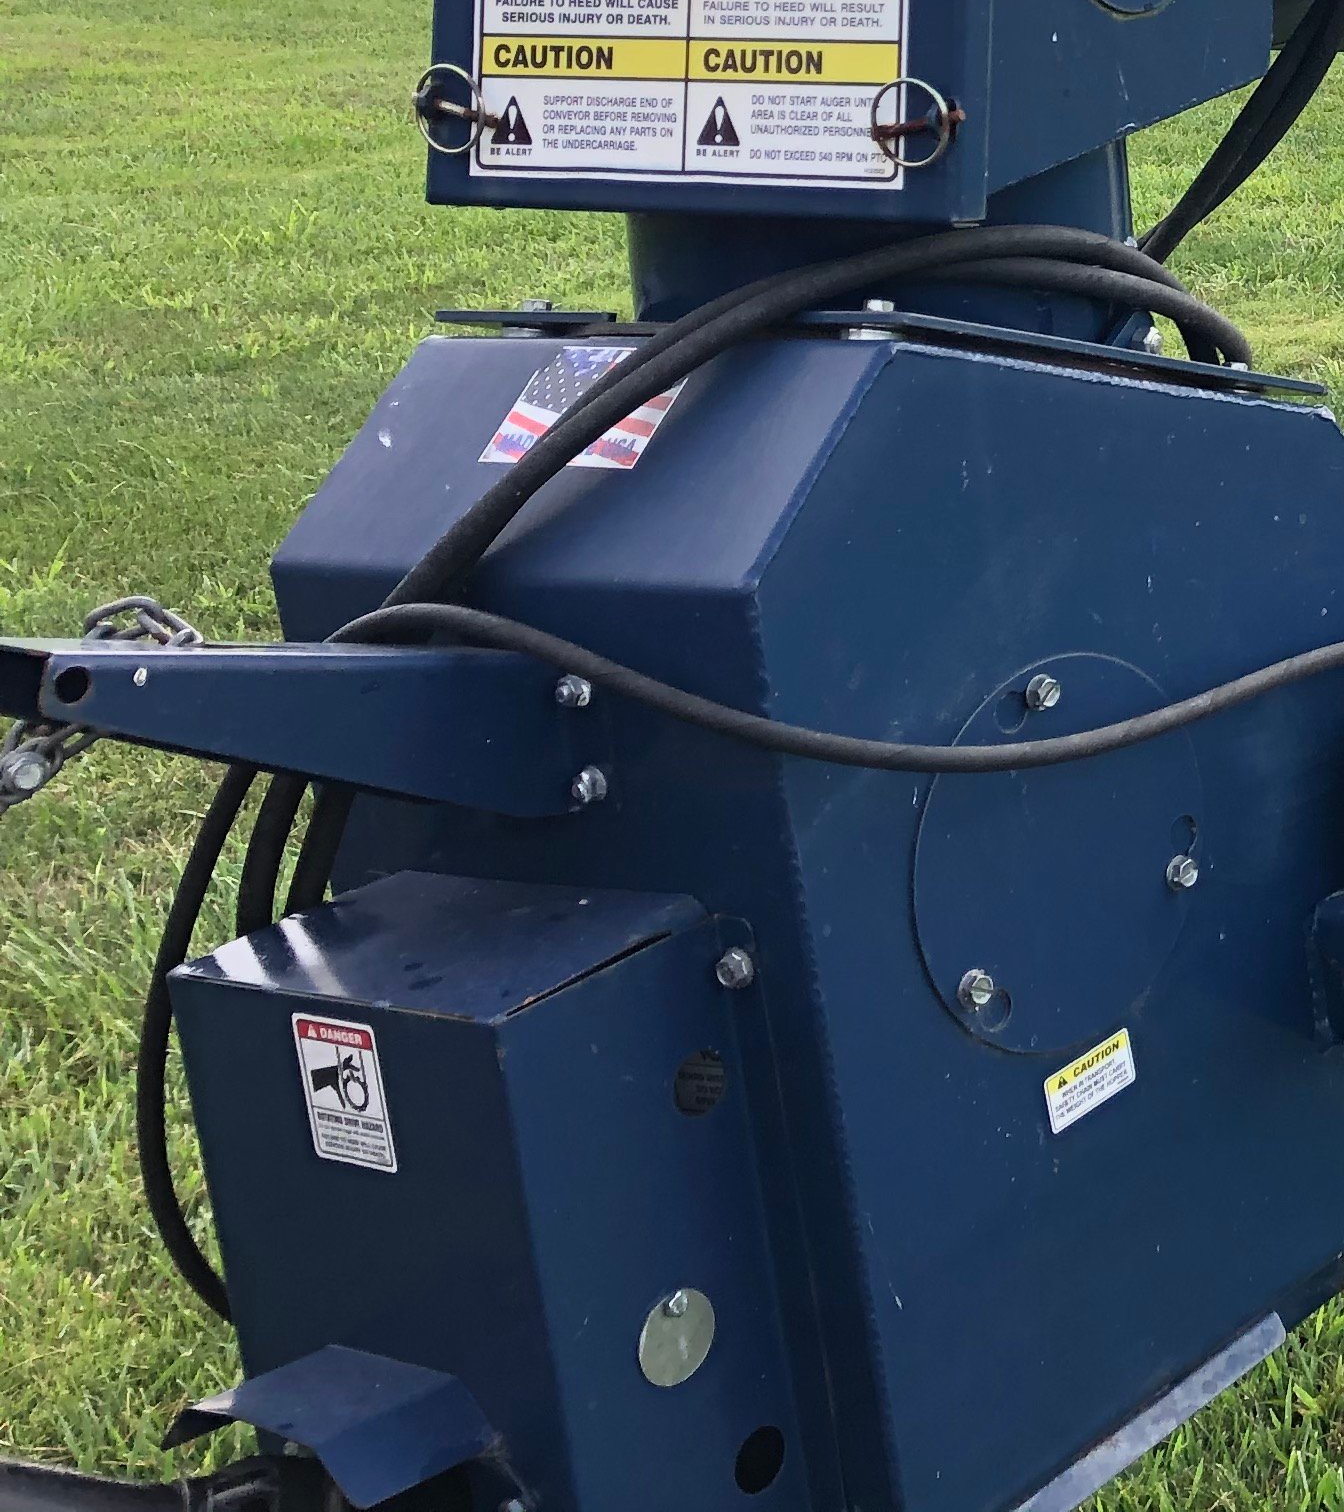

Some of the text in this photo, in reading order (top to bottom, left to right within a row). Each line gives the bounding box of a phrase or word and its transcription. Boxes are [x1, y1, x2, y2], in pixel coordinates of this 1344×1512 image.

[702, 1, 885, 13] FAILURE TO HEED WILL RESULT
[501, 12, 554, 23] SERIOUS
[558, 12, 602, 23] INJURY
[605, 13, 623, 24] OR
[703, 15, 715, 24] IN
[719, 16, 770, 25] SERIOUS
[774, 16, 816, 26] INJURY
[819, 17, 837, 26] OR
[493, 44, 614, 72] CAUTION
[702, 48, 824, 76] CAUTION
[543, 96, 673, 108] SUPPORT DISCHARGE END OF
[751, 95, 873, 107] DO NOT START AUGER UNT
[542, 110, 677, 122] CONVEYOR BEFORE REMOVING
[750, 110, 852, 122] AREA IS CLEAR OF ALL
[542, 125, 673, 137] OR REPLACING ANY PARTS ON
[750, 125, 873, 137] UNAUTHORIZED PERSONNE
[542, 139, 558, 148] THE
[504, 148, 532, 156] ALERT
[711, 149, 740, 157] ALERT
[749, 149, 888, 163] DO NOT EXCEED 540 RPM ON PTO
[502, 432, 536, 449] MAD
[320, 1027, 362, 1045] DANGER
[1073, 1040, 1120, 1077] CAUTION
